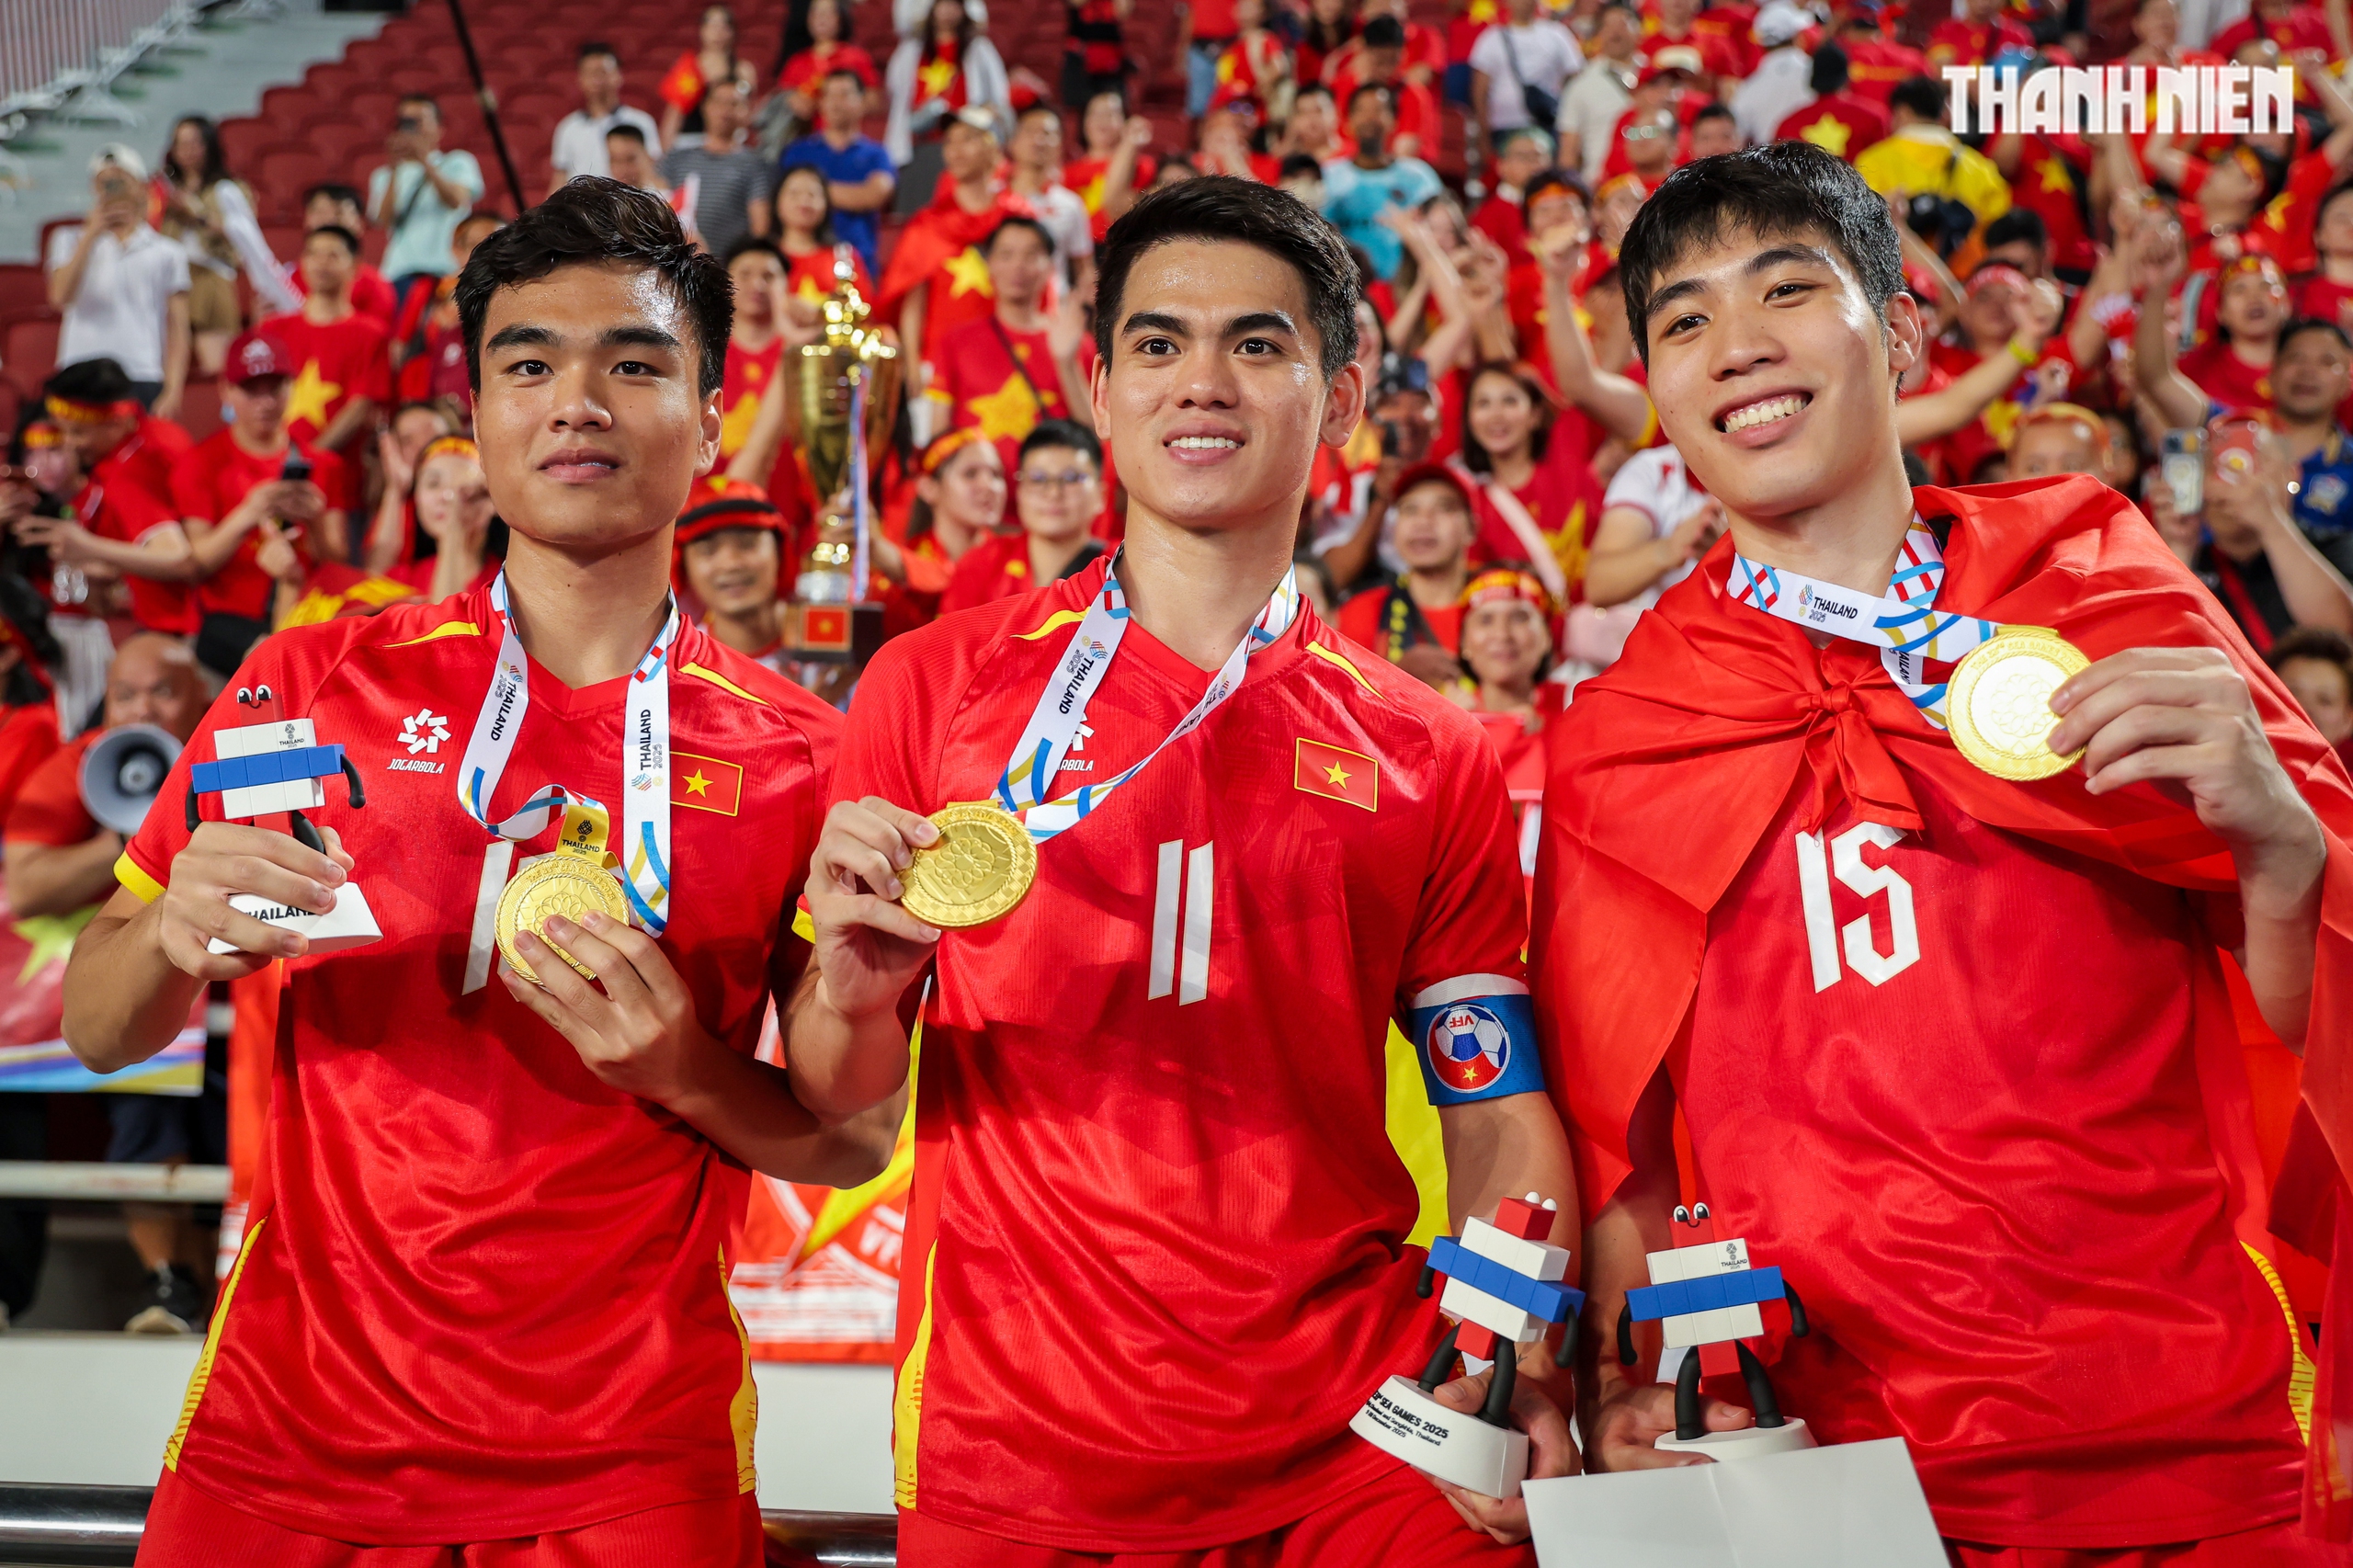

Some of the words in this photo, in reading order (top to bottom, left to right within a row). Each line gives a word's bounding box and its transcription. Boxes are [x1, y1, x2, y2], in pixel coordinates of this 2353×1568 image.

[1808, 609, 1826, 623] 2025
[1813, 597, 1858, 619] THAILAND
[2007, 641, 2026, 650] SEA
[1066, 649, 1085, 675] 2025
[1058, 657, 1095, 714] THAILAND
[490, 681, 517, 742] THAILAND
[640, 709, 652, 771] THAILAND
[653, 743, 663, 769] 2025
[387, 758, 445, 774] JOGARBOLA
[1057, 759, 1094, 771] RBOLA
[562, 839, 600, 853] THAILAND
[573, 847, 587, 856] 2025
[1795, 821, 1921, 994] 15
[1148, 838, 1214, 1006] 11
[1449, 1015, 1474, 1028] VFF
[1721, 1258, 1747, 1267] THAILAND
[1380, 1397, 1393, 1411] SEA
[1392, 1404, 1422, 1426] GAMES
[1421, 1421, 1450, 1439] 2025
[1391, 1426, 1407, 1438] 2025
[1415, 1430, 1441, 1447] Thailand
